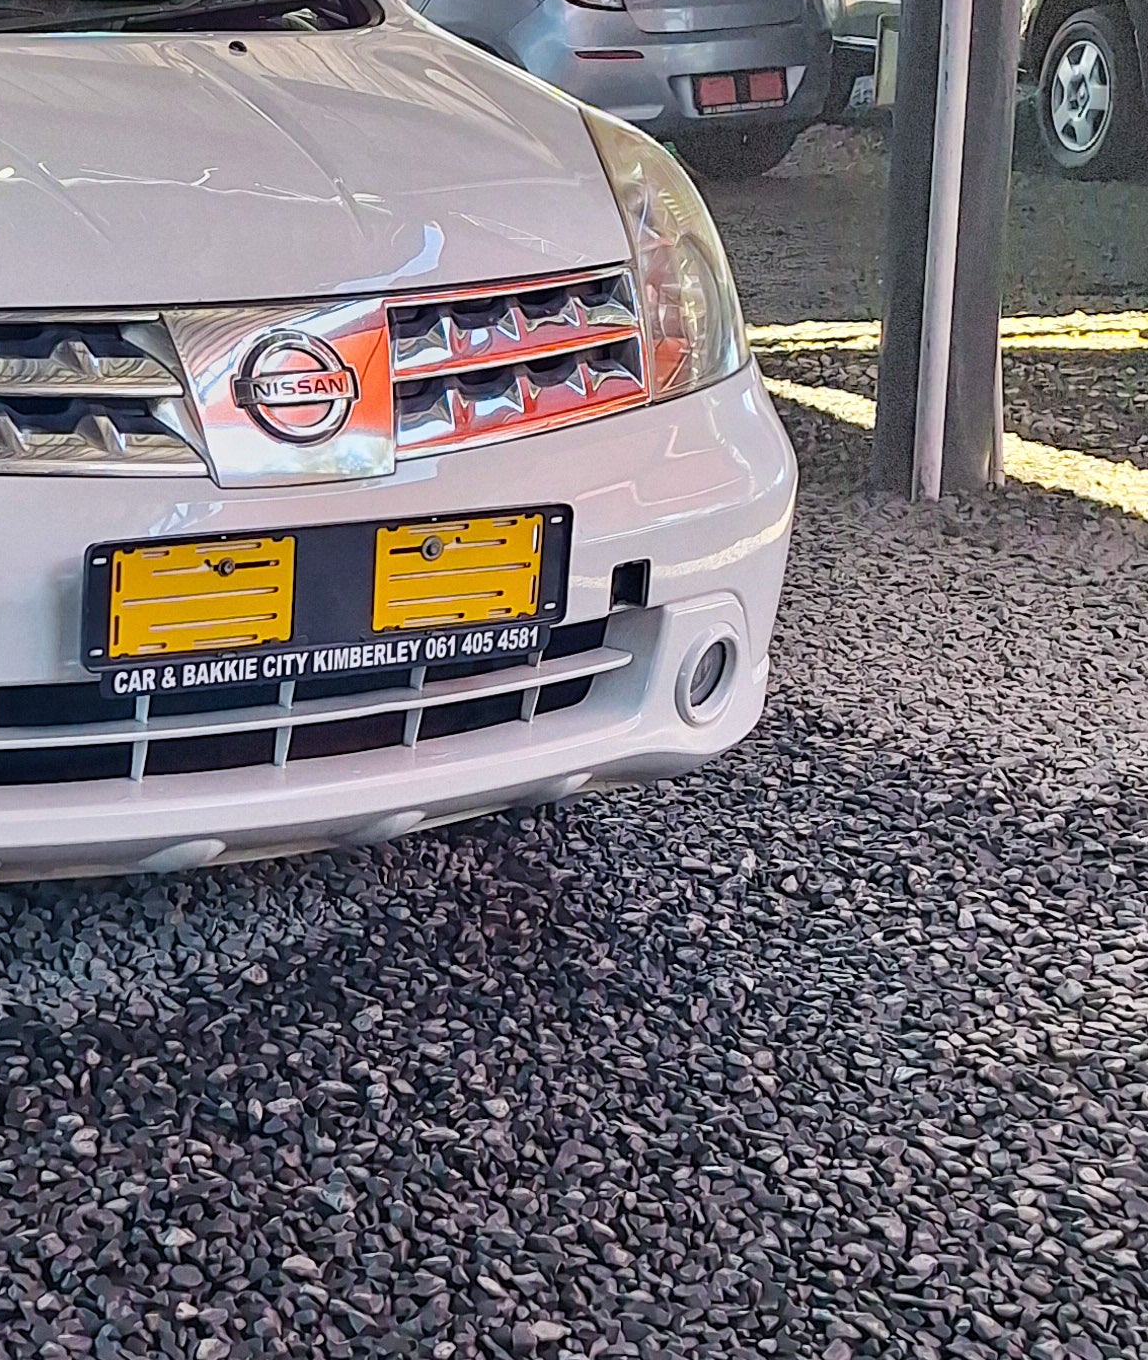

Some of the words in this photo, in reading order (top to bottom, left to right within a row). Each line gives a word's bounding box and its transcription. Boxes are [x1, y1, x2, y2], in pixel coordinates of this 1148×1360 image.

[252, 378, 344, 399] NISSAN
[114, 669, 156, 694] CAR
[161, 666, 177, 689] &
[182, 657, 258, 687] BAKKIE
[262, 650, 309, 678] CITY
[313, 639, 422, 673] KIMBERLEY
[425, 635, 456, 660] 061
[461, 630, 494, 655] 405
[497, 625, 539, 650] 4581
